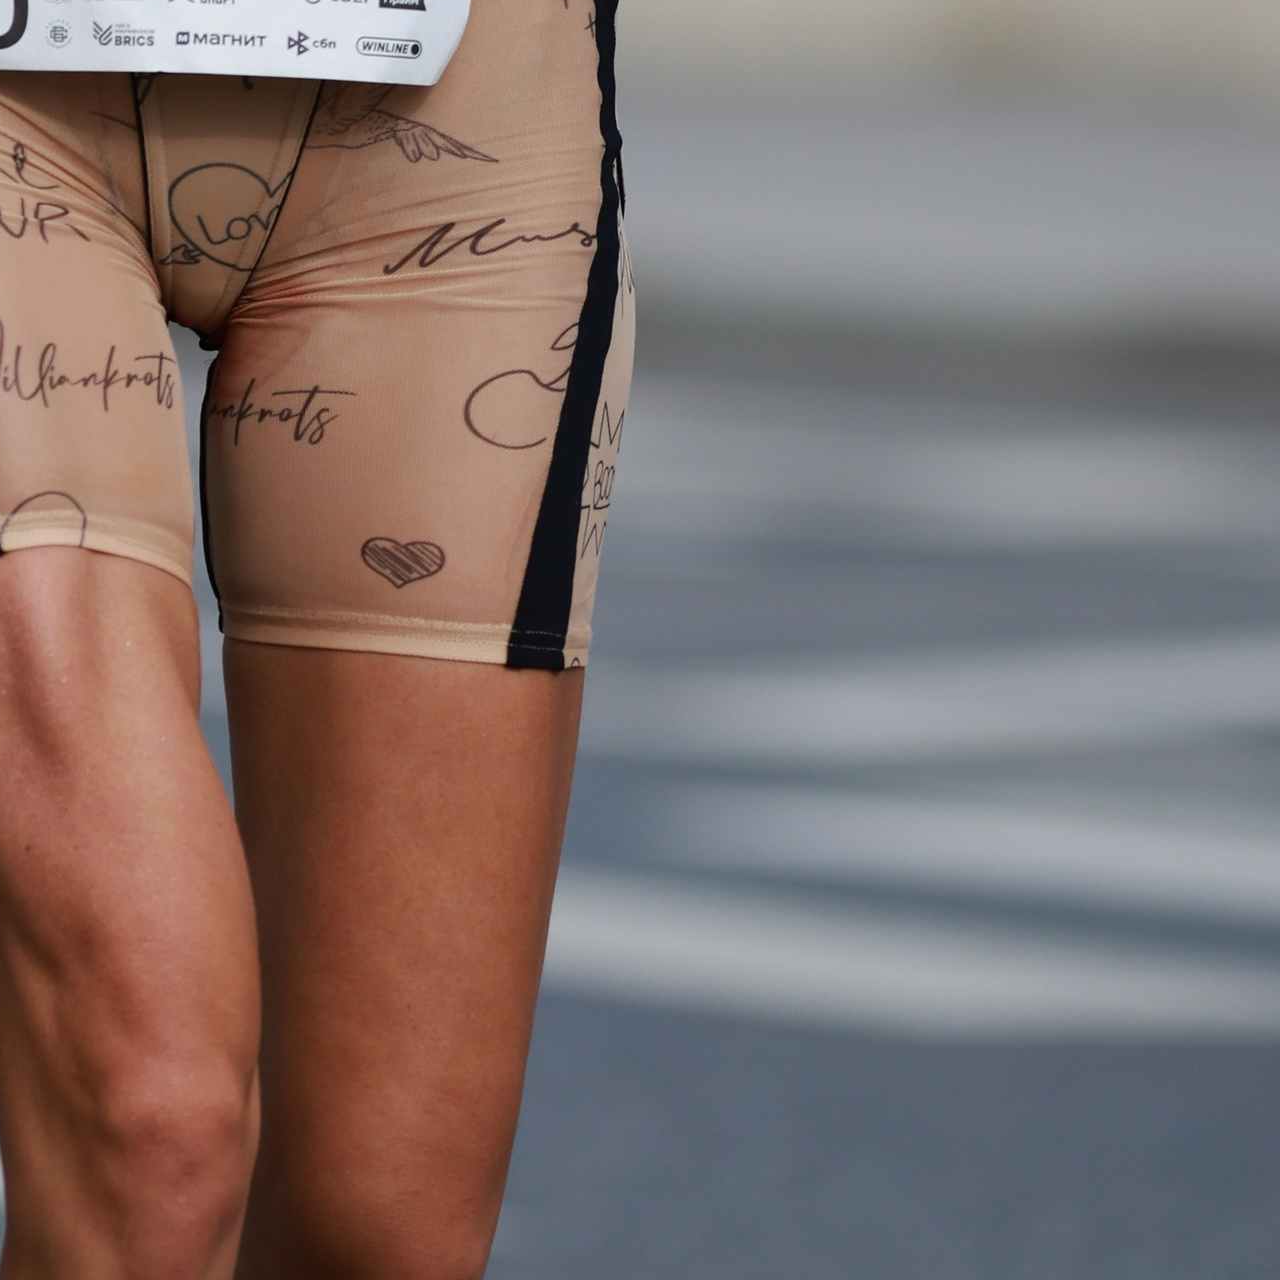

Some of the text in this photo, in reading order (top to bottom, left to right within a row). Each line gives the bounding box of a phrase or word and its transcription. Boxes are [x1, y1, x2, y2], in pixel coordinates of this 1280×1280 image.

[114, 35, 155, 47] BRICS
[193, 32, 267, 48] магнит
[362, 40, 410, 54] WINLINE
